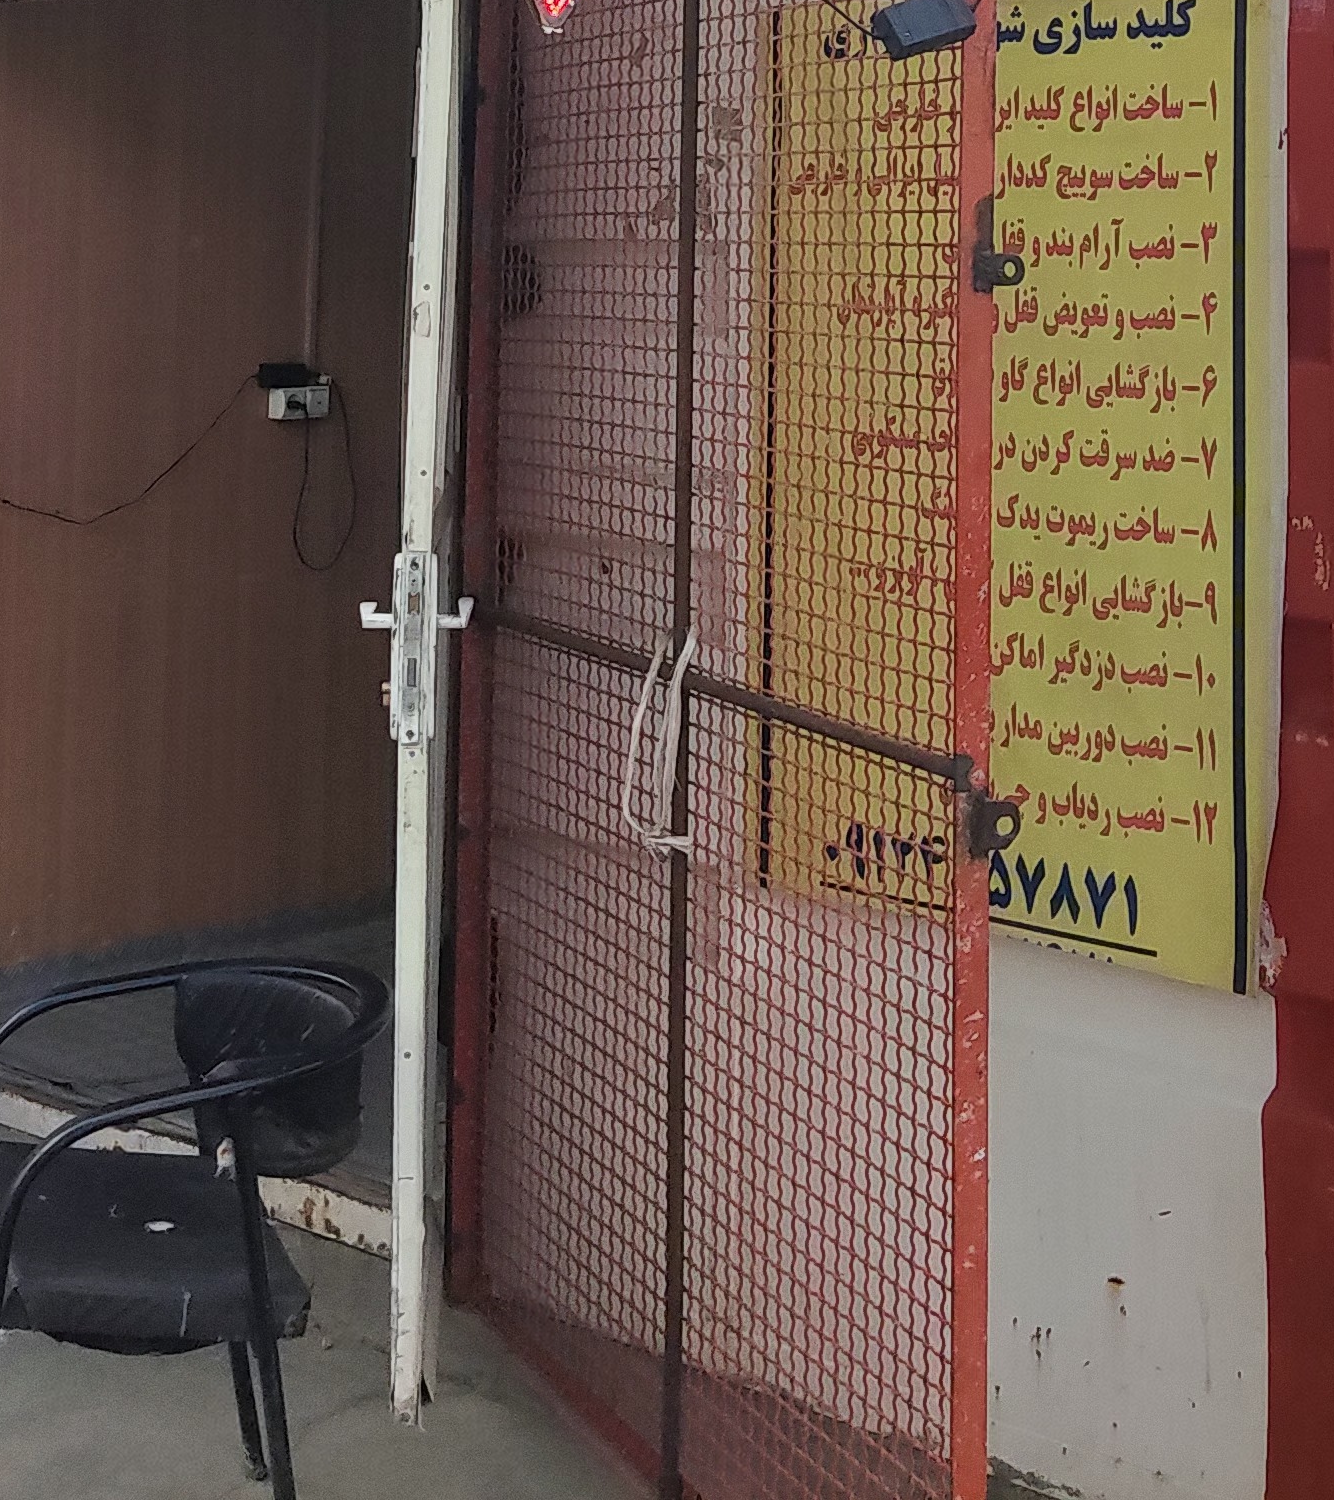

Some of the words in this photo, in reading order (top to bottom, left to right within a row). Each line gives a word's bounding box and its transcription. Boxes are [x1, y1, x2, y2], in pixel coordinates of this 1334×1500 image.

[1033, 0, 1118, 55] سازی
[1024, 84, 1065, 130] کلید
[1069, 83, 1117, 132] انواع
[1123, 82, 1184, 121] ساخت
[1118, 152, 1179, 191] ساخت
[1030, 235, 1041, 268] و
[1045, 226, 1074, 269] بند
[1079, 218, 1125, 271] آرام
[1128, 223, 1175, 270] نصب
[1004, 286, 1039, 334] قفل
[1042, 291, 1109, 339] تعویض
[1112, 308, 1125, 341] و
[1129, 294, 1176, 340] نصب
[1032, 357, 1081, 407] انواع
[1021, 429, 1075, 476] کردن
[1079, 428, 1138, 481] سرقت
[1142, 437, 1176, 473] ضد
[996, 493, 1040, 541] یدک
[1045, 504, 1109, 551] ریموت
[1113, 505, 1176, 545] ساخت
[999, 560, 1034, 608] قفل
[1039, 567, 1087, 617] انواع
[1047, 640, 1116, 692] دزدگیر
[1120, 651, 1168, 694] نصب
[1000, 701, 1043, 748] مدار
[1047, 721, 1116, 763] دوربین
[1120, 723, 1168, 767] نصب
[1035, 791, 1047, 825] و
[1051, 780, 1112, 837] ردیاب
[1116, 795, 1165, 838] نصب
